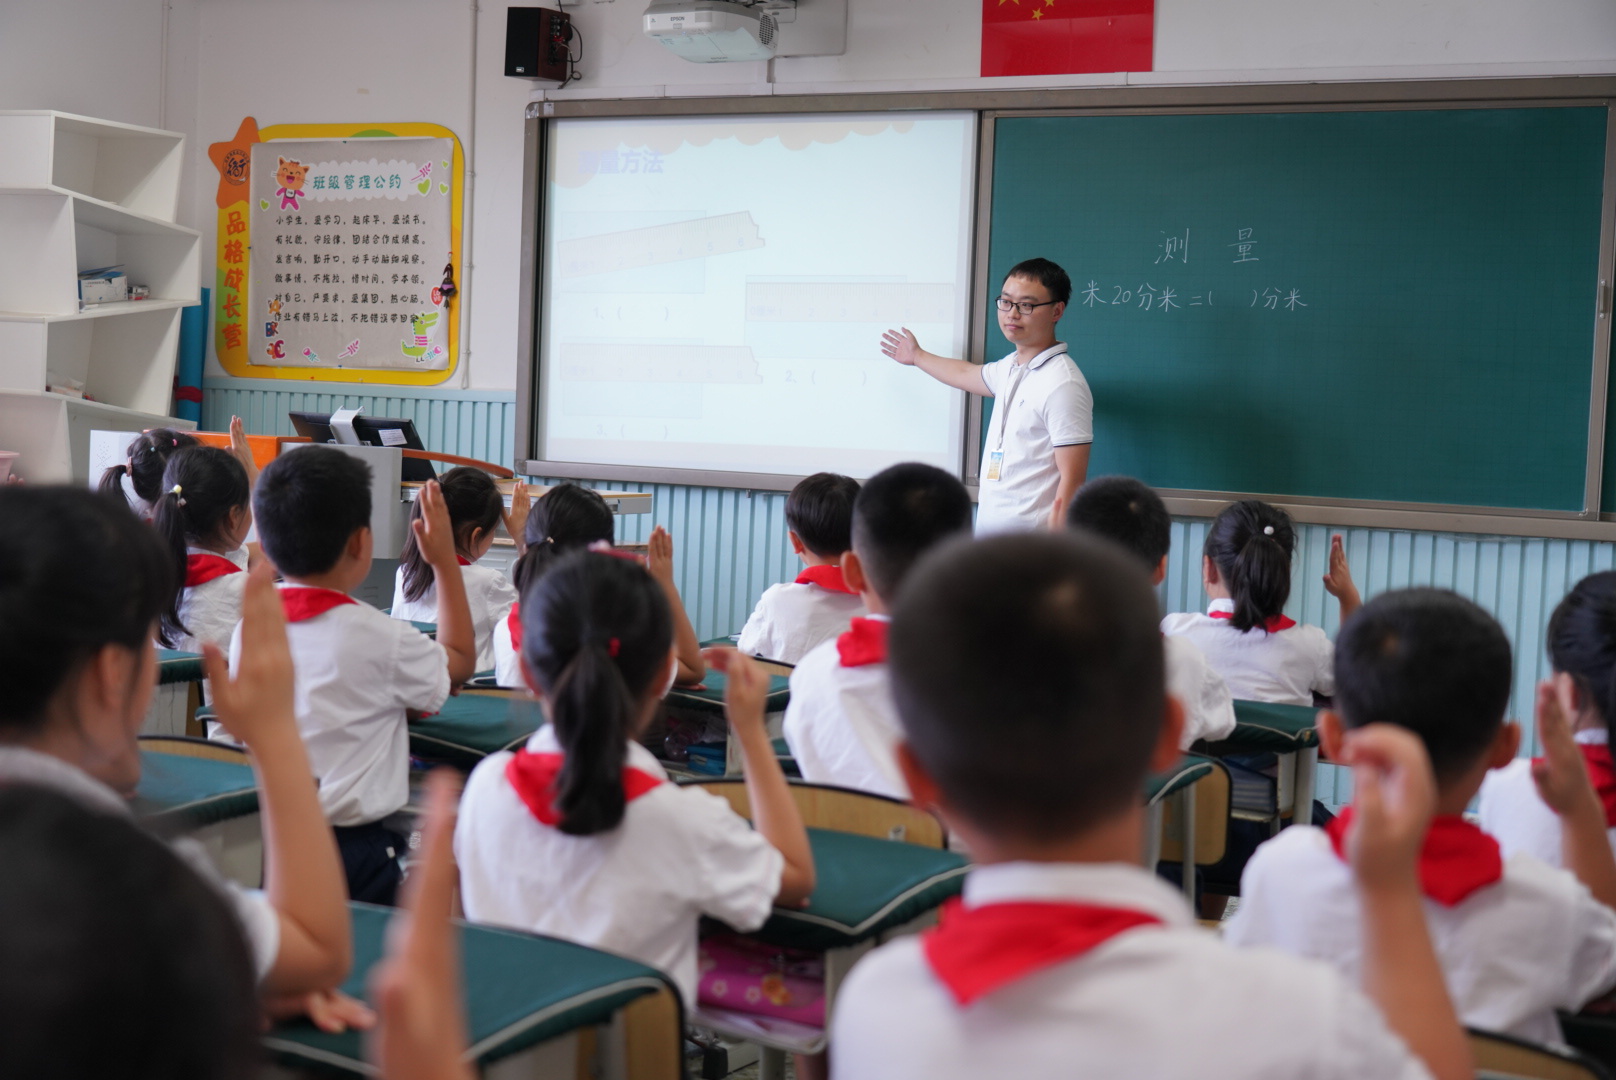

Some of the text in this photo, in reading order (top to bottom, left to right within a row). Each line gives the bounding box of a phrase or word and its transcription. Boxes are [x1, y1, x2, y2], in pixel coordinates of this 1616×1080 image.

[312, 174, 402, 191] 班级管理公约
[221, 210, 246, 351] 品格成长营
